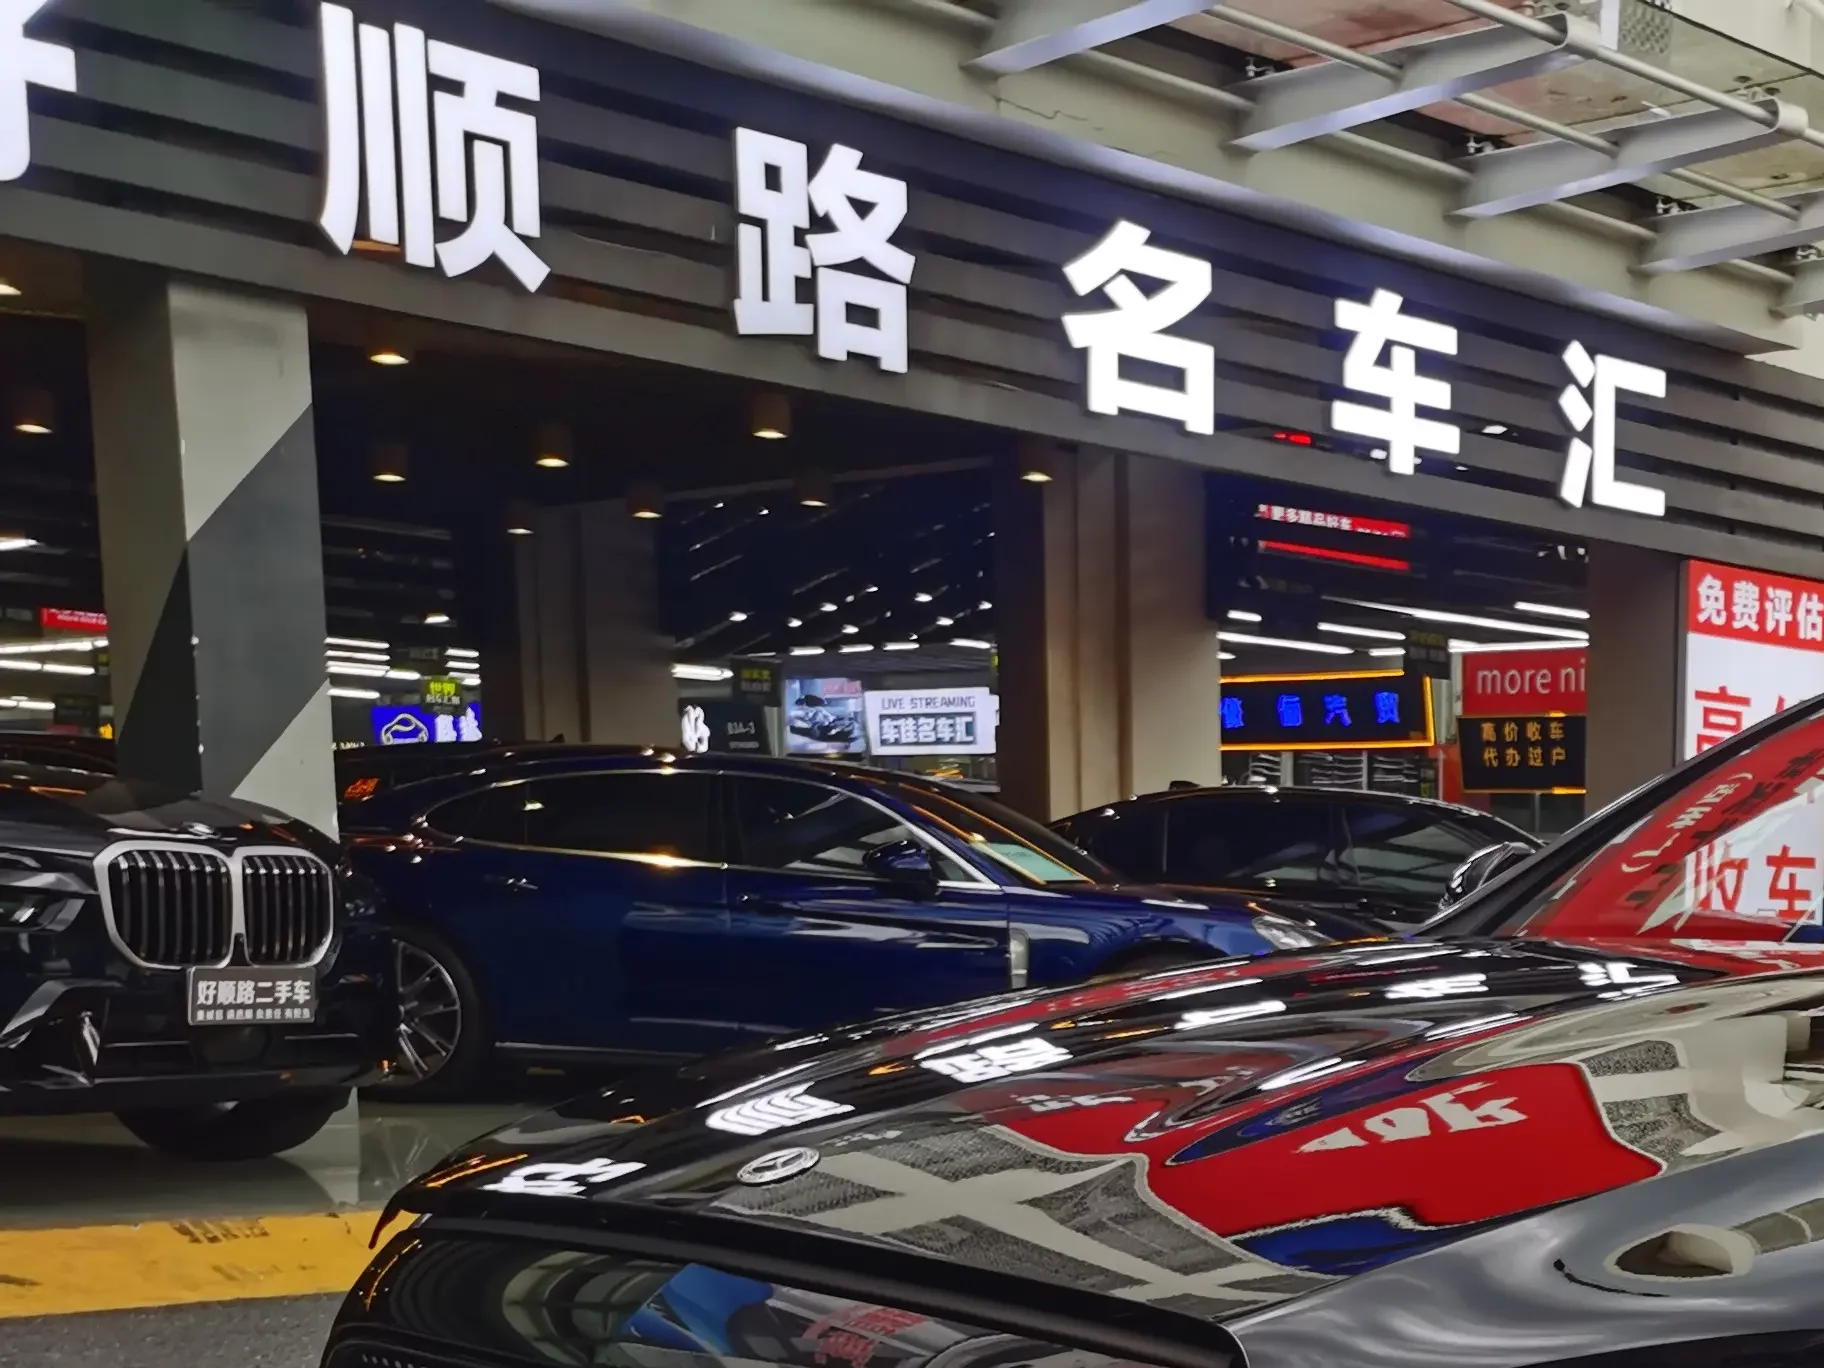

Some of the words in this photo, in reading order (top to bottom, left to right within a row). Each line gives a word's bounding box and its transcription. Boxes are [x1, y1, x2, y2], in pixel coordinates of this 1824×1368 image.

[1697, 573, 1824, 641] 免费评估
[1476, 668, 1552, 696] more
[881, 698, 905, 710] LIVE
[910, 696, 976, 709] STREAMING
[1480, 721, 1566, 743] 高价收车
[1483, 746, 1567, 768] 代办过户
[1694, 842, 1817, 921] 收车
[197, 980, 311, 1006] 好顺路二手车
